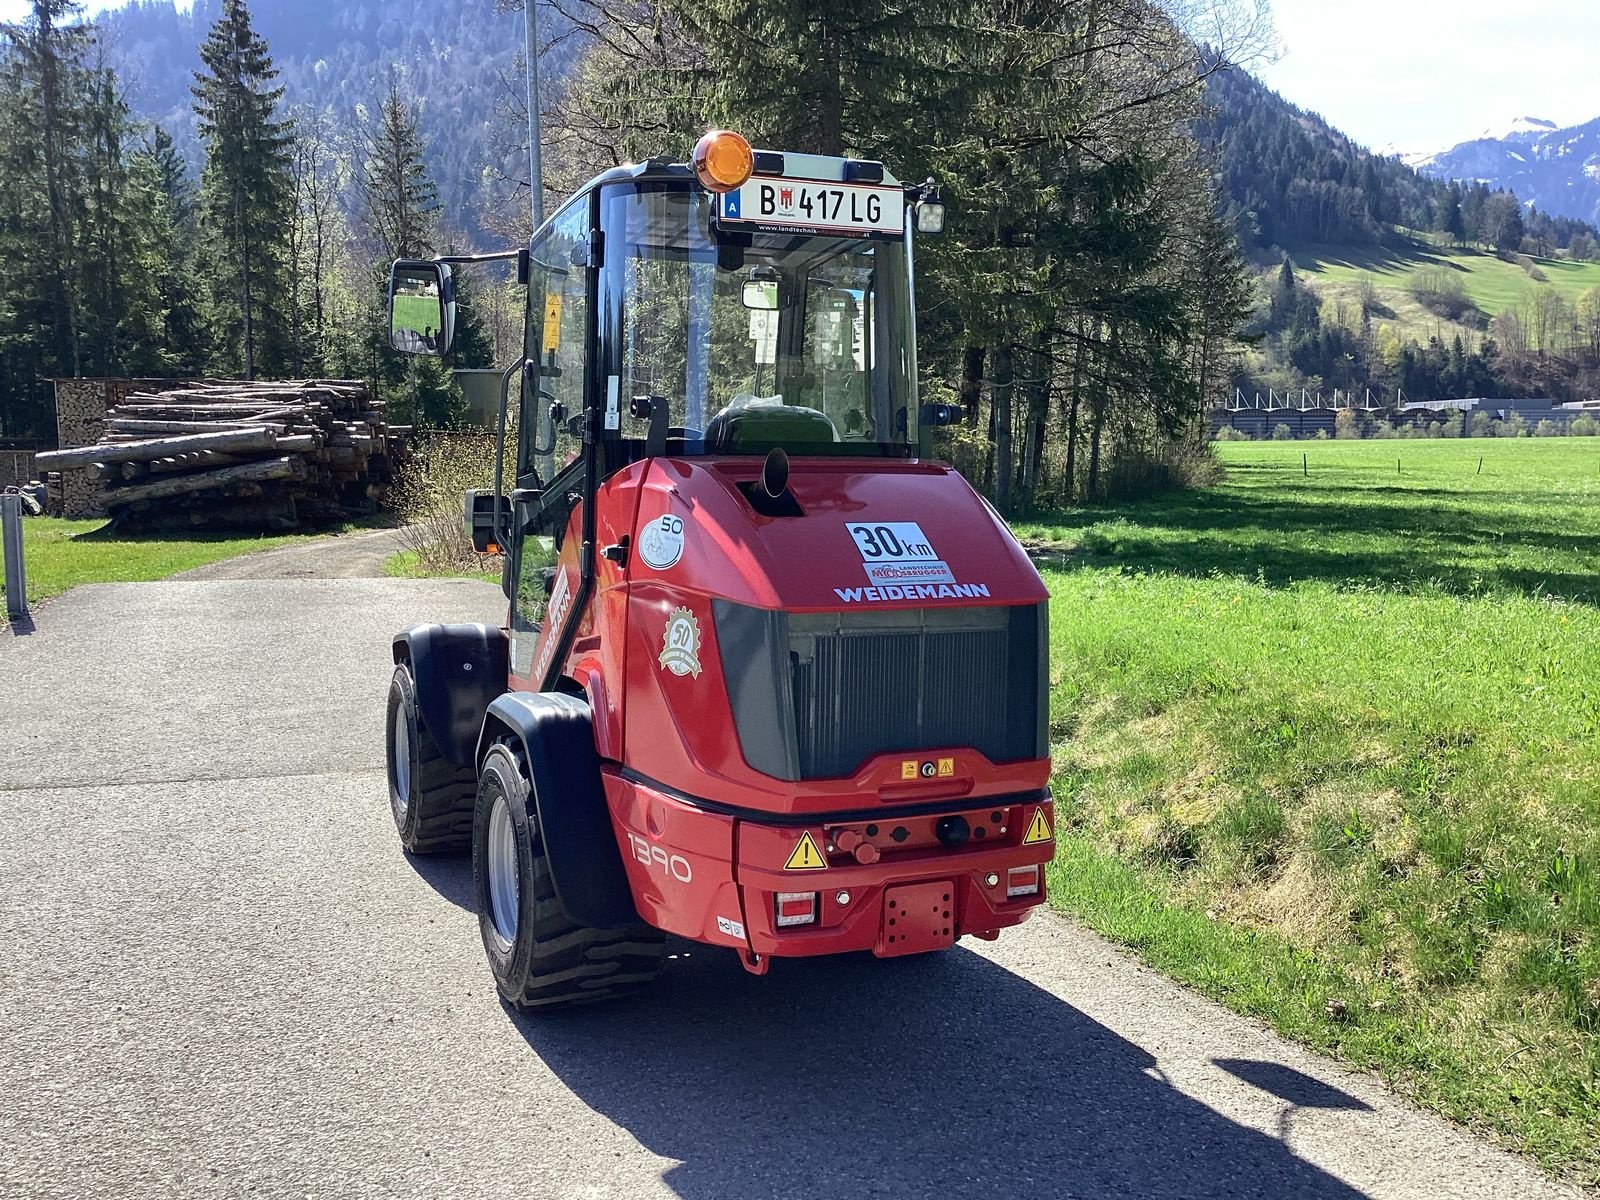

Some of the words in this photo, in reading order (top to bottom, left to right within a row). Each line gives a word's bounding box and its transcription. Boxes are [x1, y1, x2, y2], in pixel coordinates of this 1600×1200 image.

[728, 202, 737, 213] A
[760, 184, 776, 215] B
[799, 188, 844, 220] 417
[851, 192, 881, 223] LG
[660, 516, 683, 535] 50
[853, 526, 904, 557] 30
[901, 539, 933, 557] km
[833, 583, 991, 603] WEIDEMANN
[673, 623, 690, 647] 50
[627, 832, 692, 883] 1390
